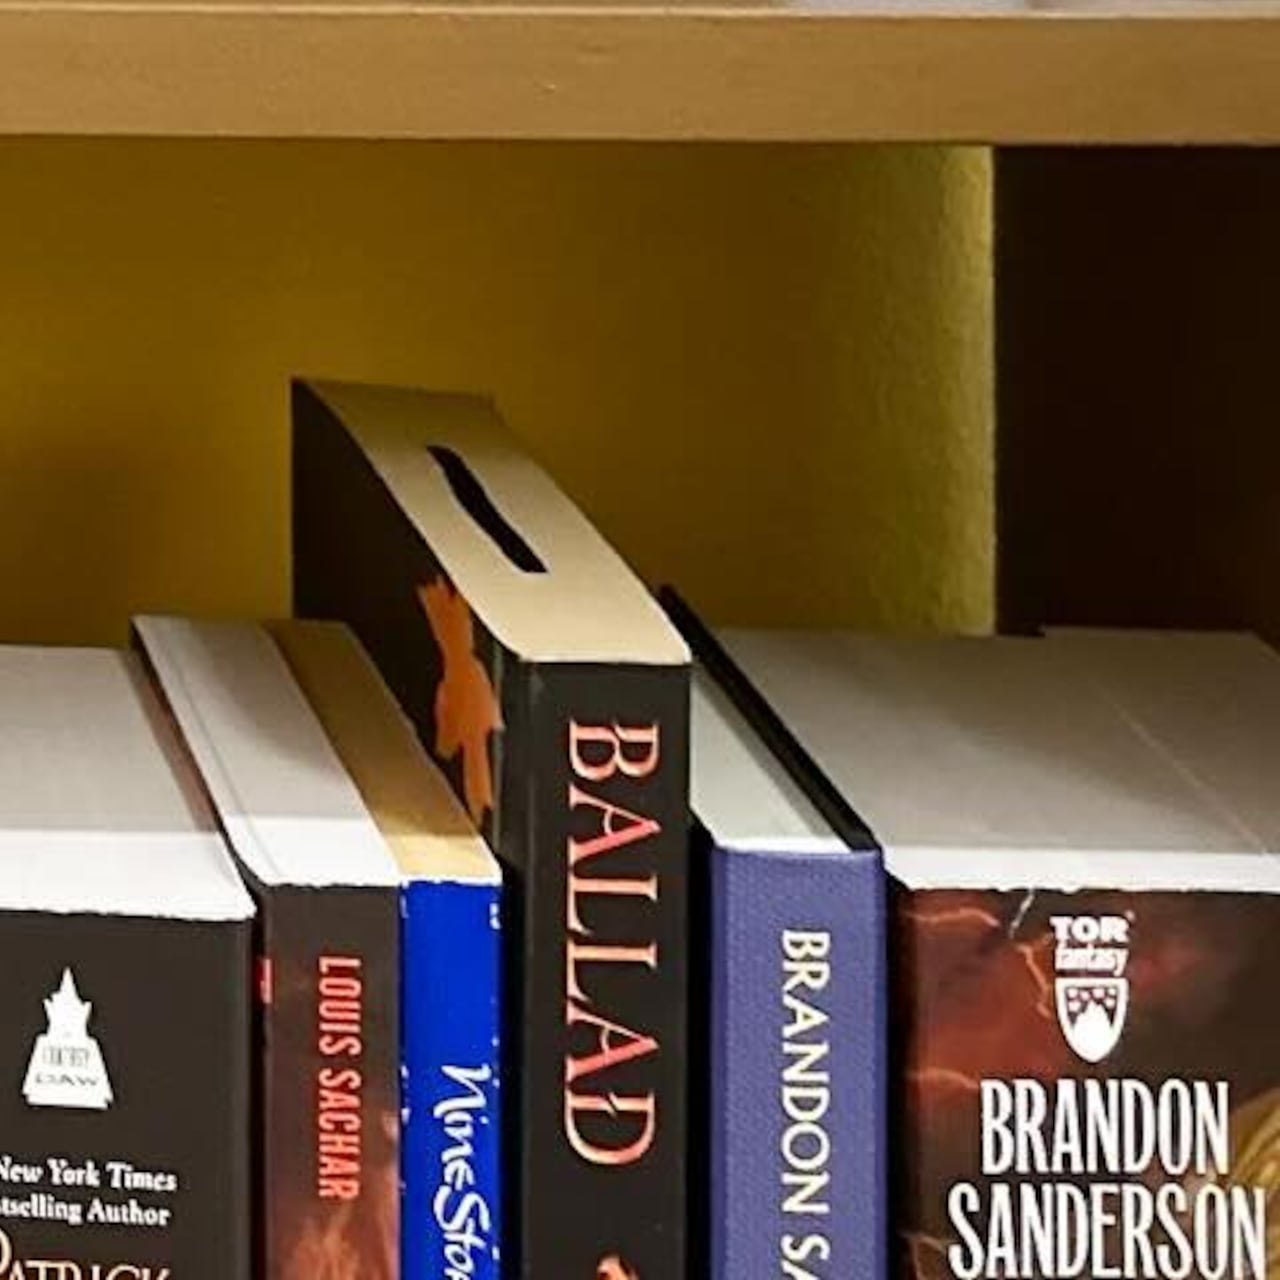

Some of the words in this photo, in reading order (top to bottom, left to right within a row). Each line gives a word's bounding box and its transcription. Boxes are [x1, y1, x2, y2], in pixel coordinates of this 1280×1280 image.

[565, 719, 662, 1167] BALLAD
[1049, 914, 1132, 943] TOR
[1055, 946, 1128, 977] fantasy
[317, 955, 363, 1057] LOUIS
[780, 928, 832, 1216] BRANDON
[47, 1159, 100, 1187] York
[105, 1163, 179, 1192] Times
[317, 1066, 363, 1201] SACHAR
[979, 1079, 1230, 1176] BRANDON
[86, 1197, 172, 1226] Author
[947, 1182, 1268, 1280] SANDERSON
